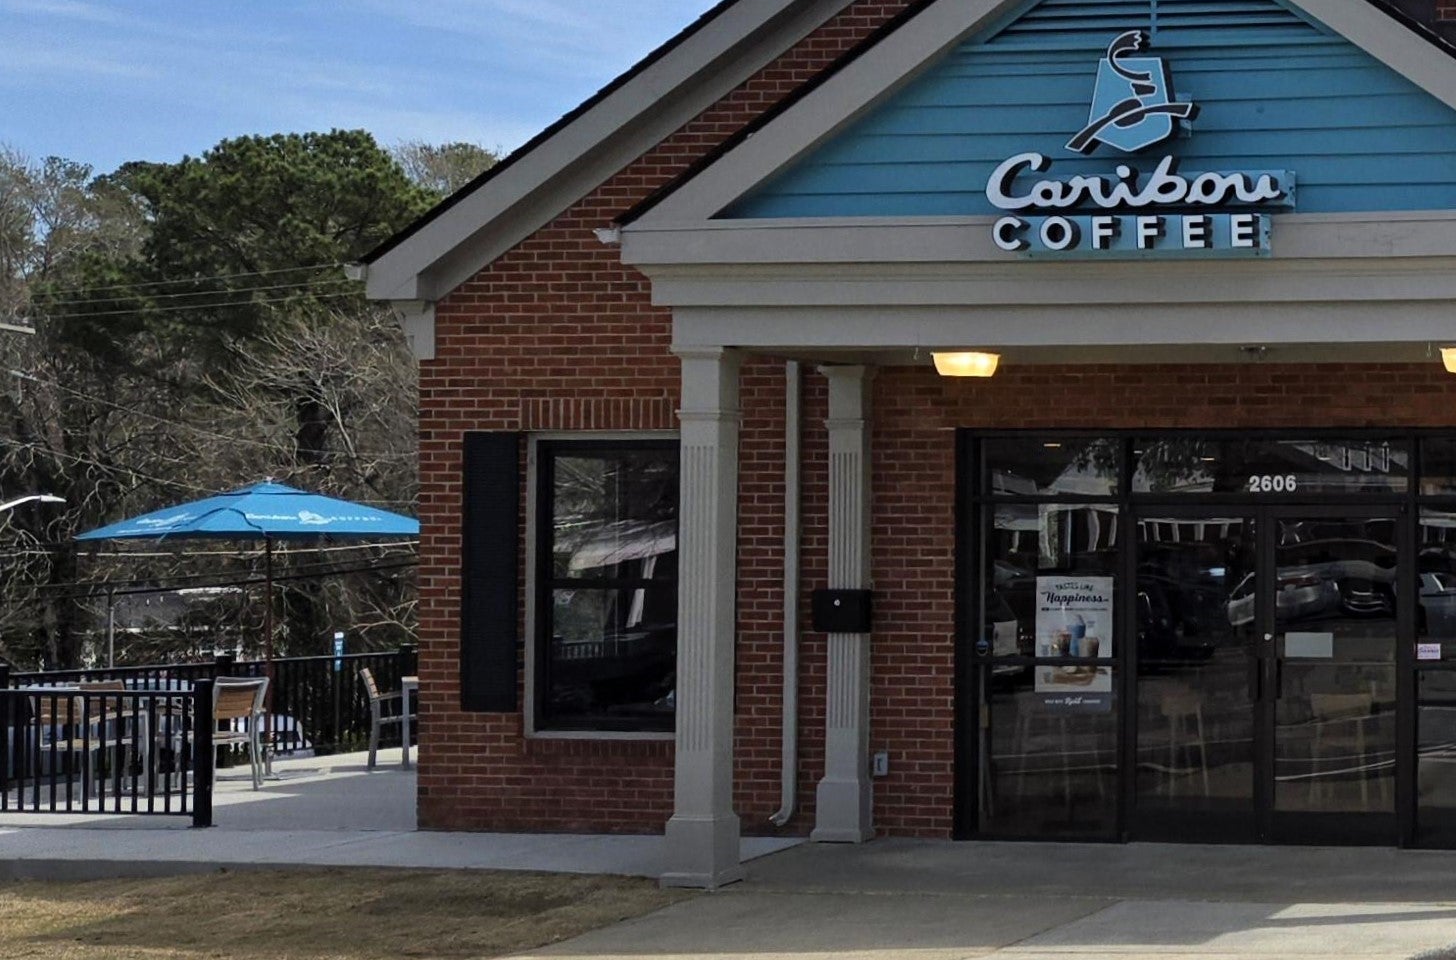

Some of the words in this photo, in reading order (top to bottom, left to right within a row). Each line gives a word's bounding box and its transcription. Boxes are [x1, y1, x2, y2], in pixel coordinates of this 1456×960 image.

[986, 151, 1280, 209] Caribou
[992, 214, 1254, 251] COFFEE
[1249, 475, 1297, 492] 2606
